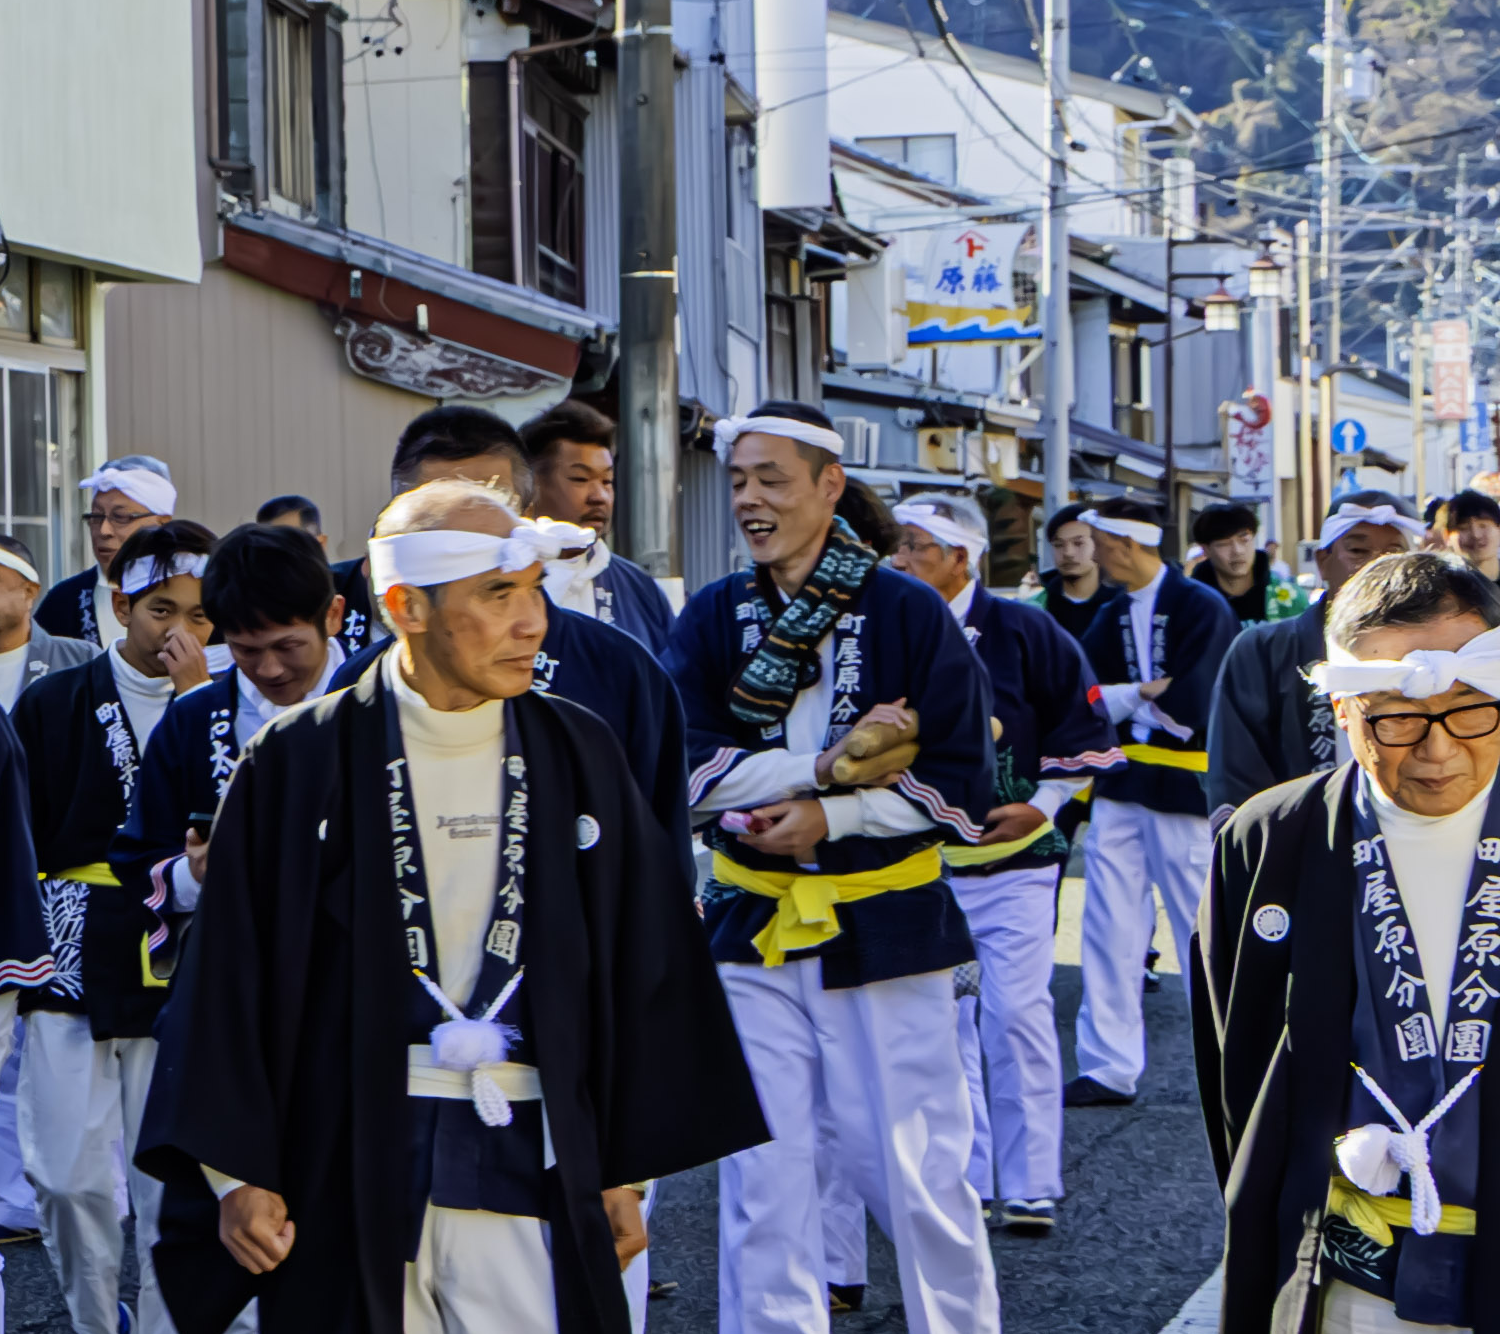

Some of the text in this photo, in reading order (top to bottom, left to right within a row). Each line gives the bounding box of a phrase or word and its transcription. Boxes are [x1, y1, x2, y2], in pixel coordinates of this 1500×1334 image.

[1352, 833, 1437, 1062] 町屋原分團
